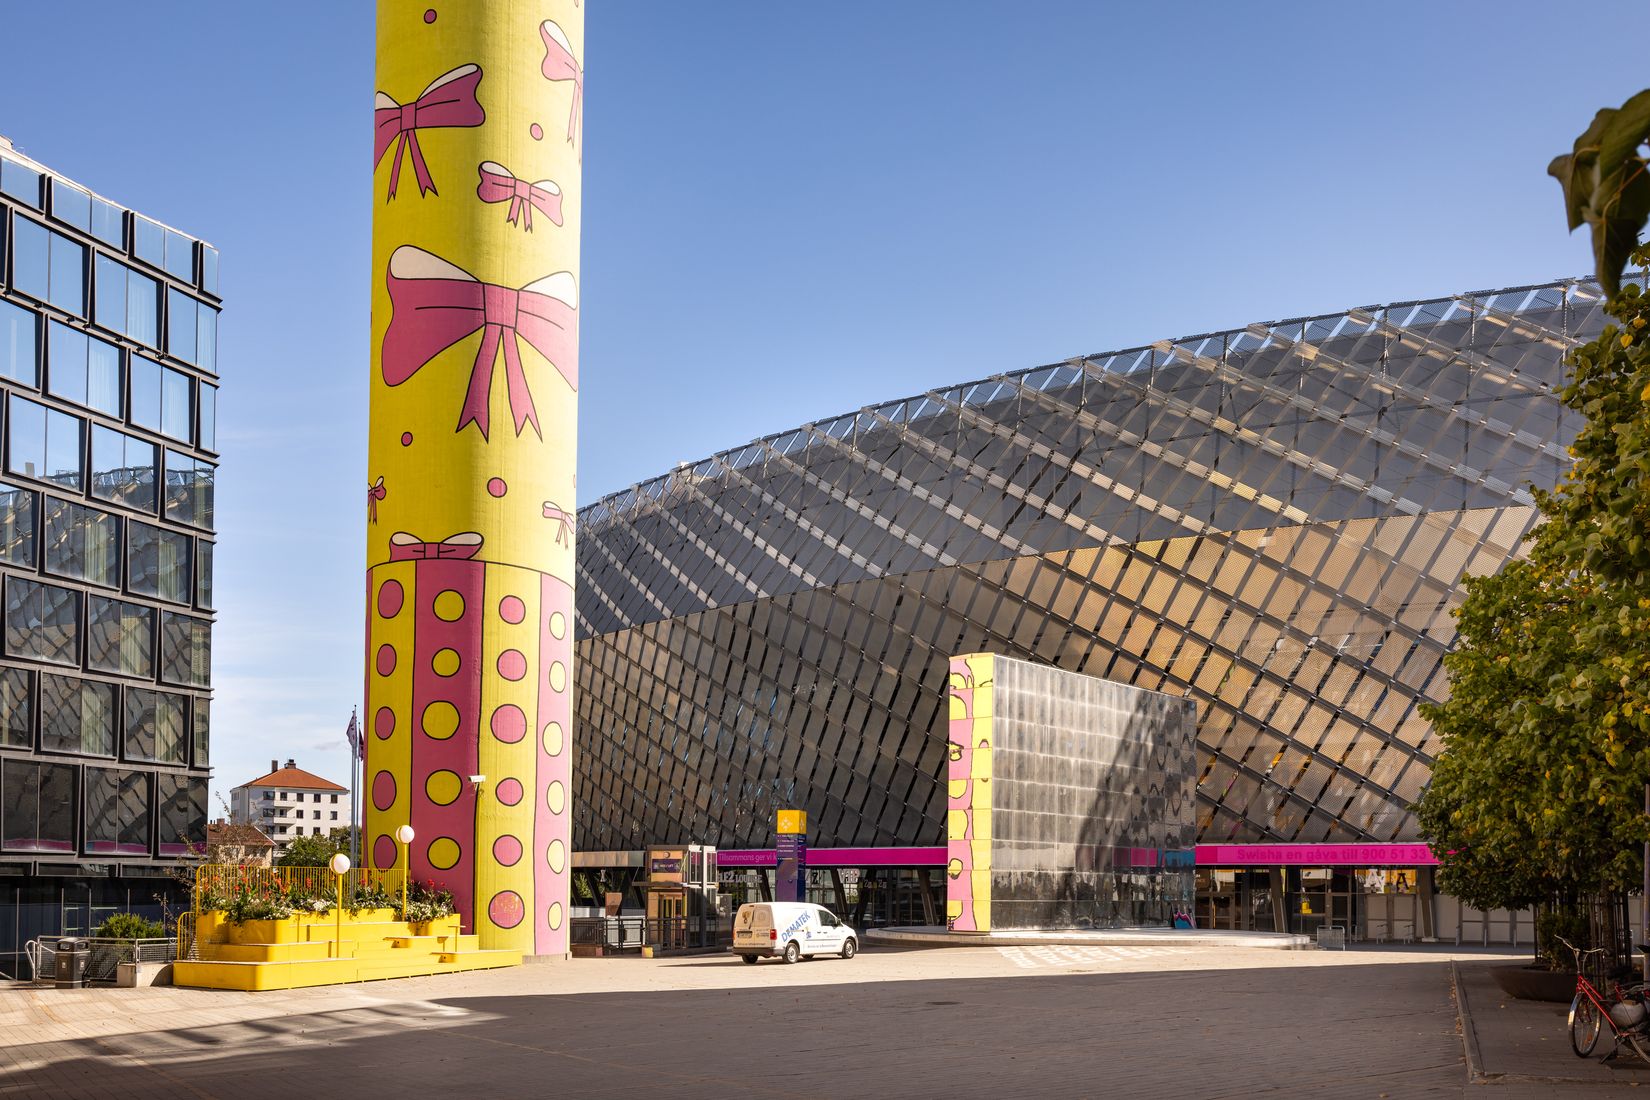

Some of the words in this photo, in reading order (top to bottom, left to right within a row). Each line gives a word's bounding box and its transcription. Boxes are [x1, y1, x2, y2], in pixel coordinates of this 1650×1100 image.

[755, 854, 766, 863] ger
[1238, 849, 1282, 859] Swisha
[1287, 851, 1302, 859] en
[1307, 849, 1337, 862] gåva
[1342, 848, 1358, 859] till
[1362, 848, 1386, 859] 900
[1390, 848, 1405, 859] 51
[781, 910, 812, 942] DEMATEK
